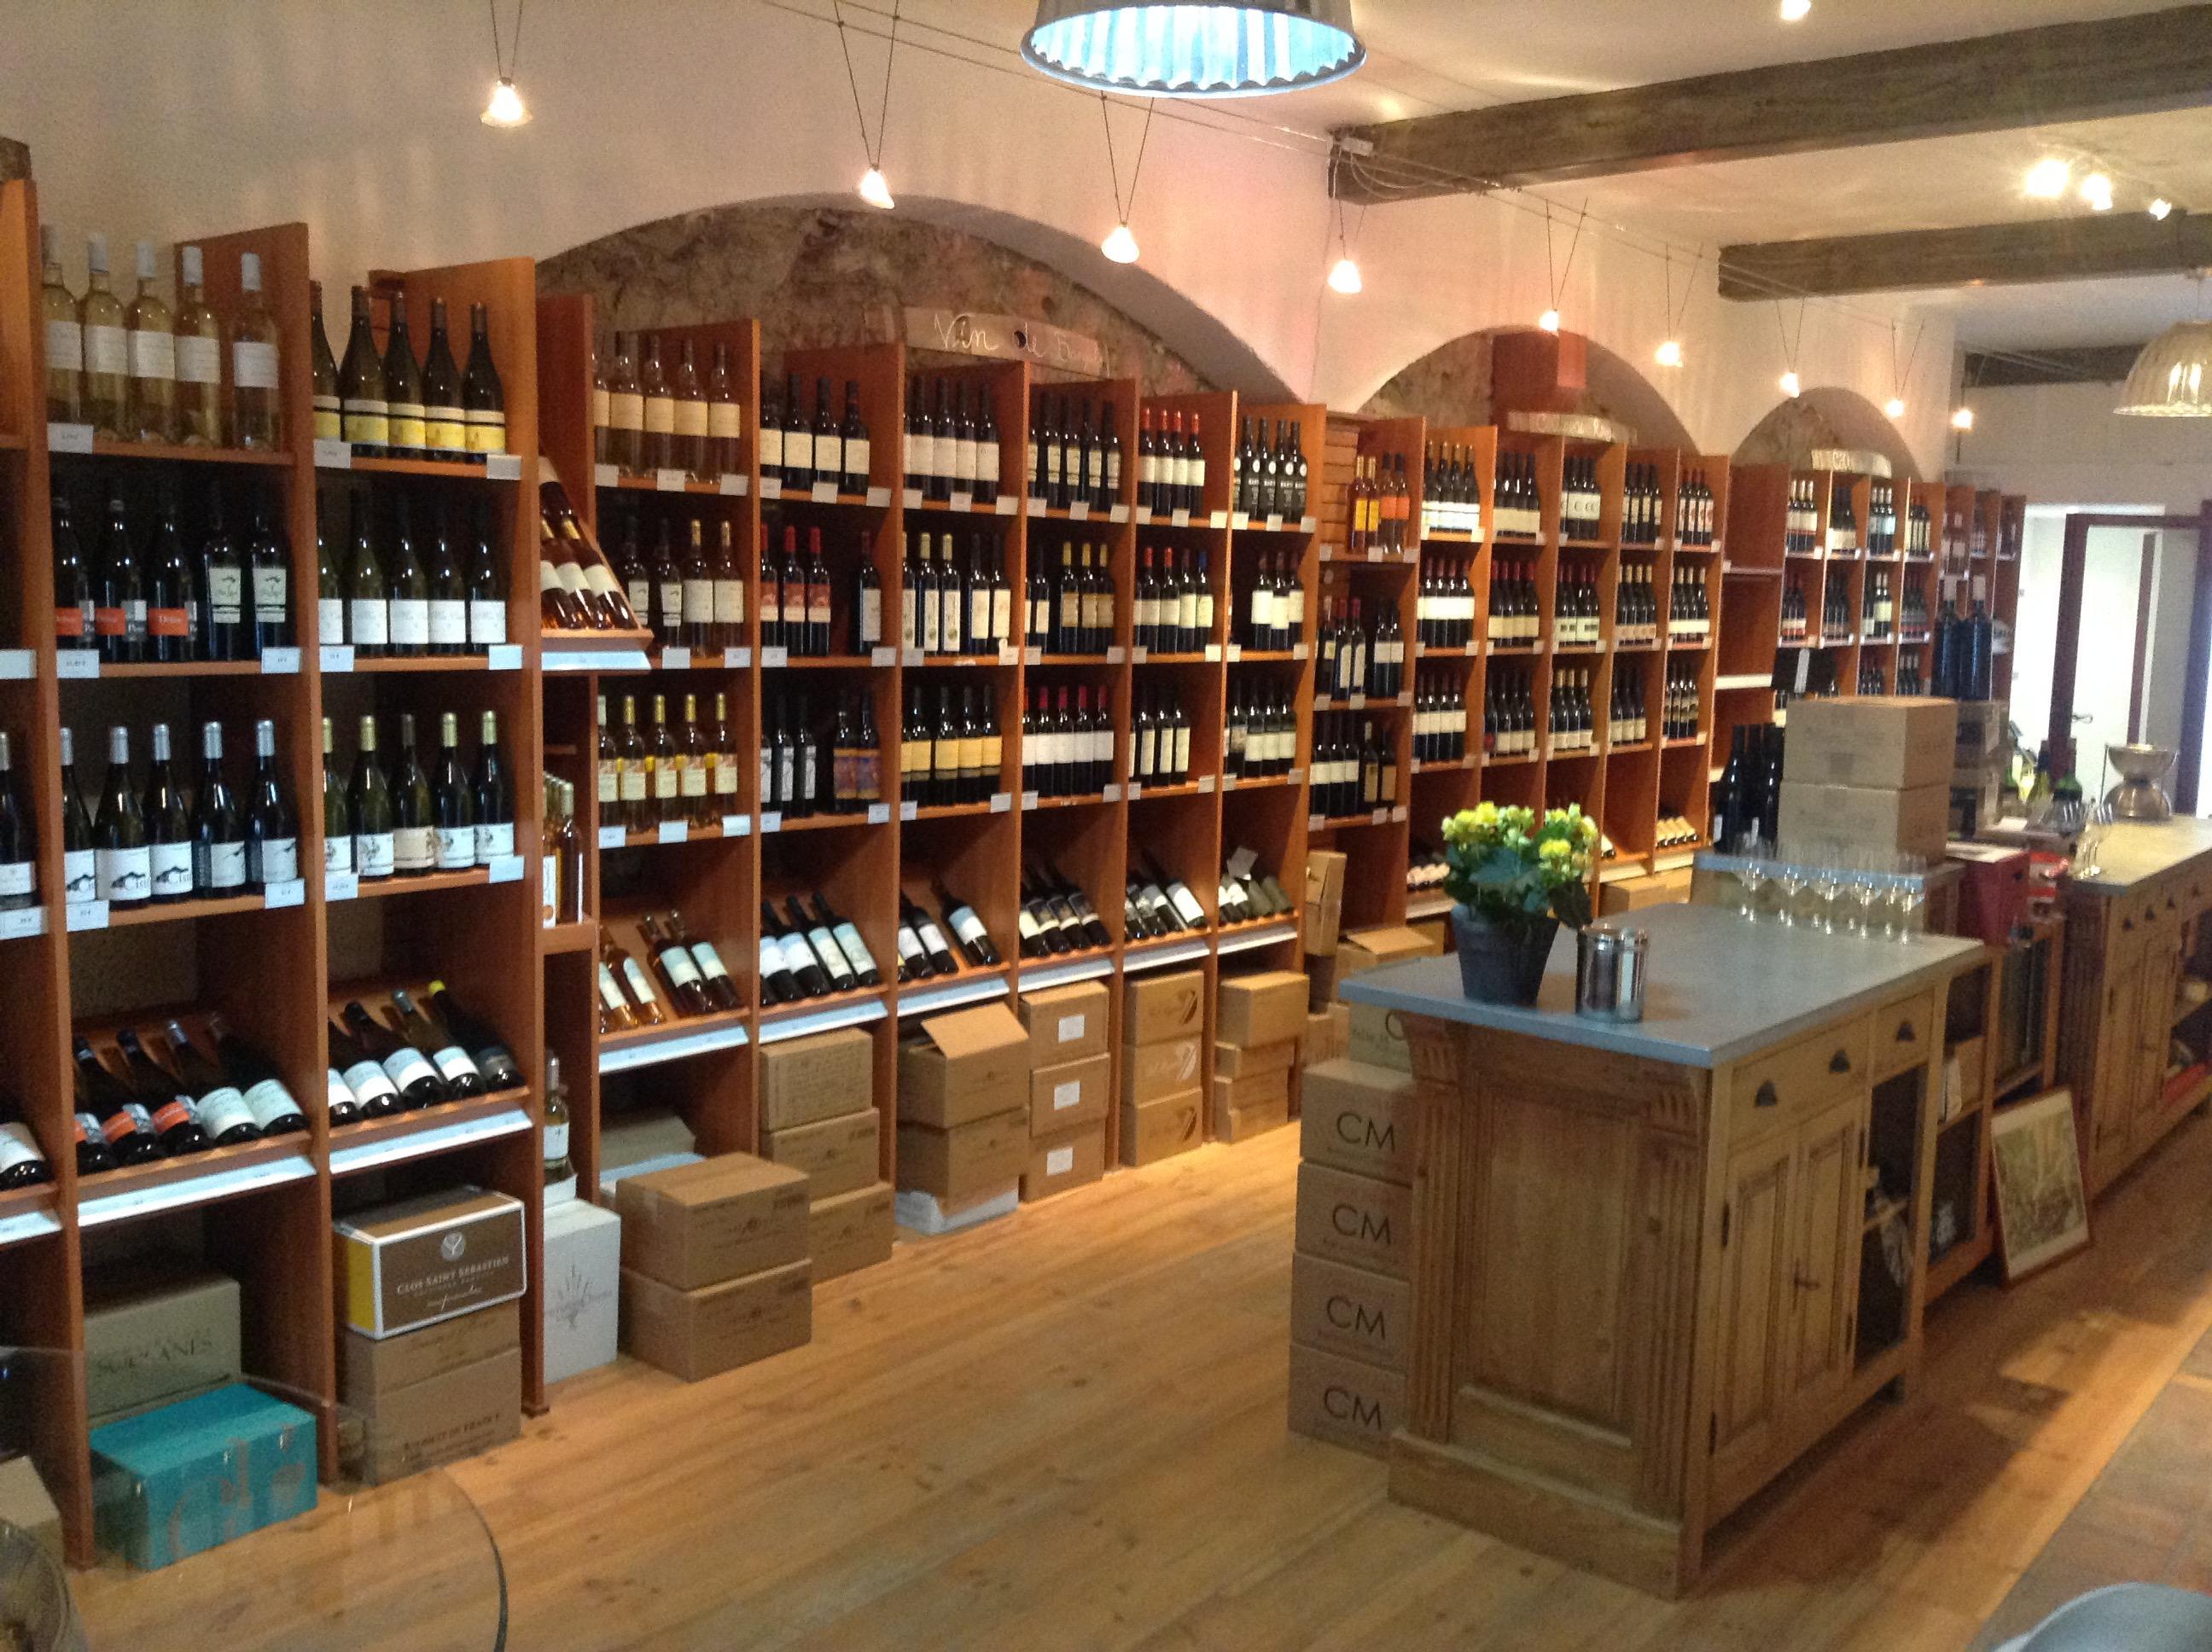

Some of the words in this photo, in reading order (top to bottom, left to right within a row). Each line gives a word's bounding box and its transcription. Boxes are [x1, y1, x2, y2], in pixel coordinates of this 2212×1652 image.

[933, 312, 999, 352] Vin
[1336, 1110, 1396, 1152] CM
[1332, 1204, 1392, 1246] CM
[396, 1280, 424, 1295] CLOS
[426, 1271, 457, 1285] SAINT
[1325, 1294, 1387, 1341] CM
[1323, 1389, 1383, 1432] CM
